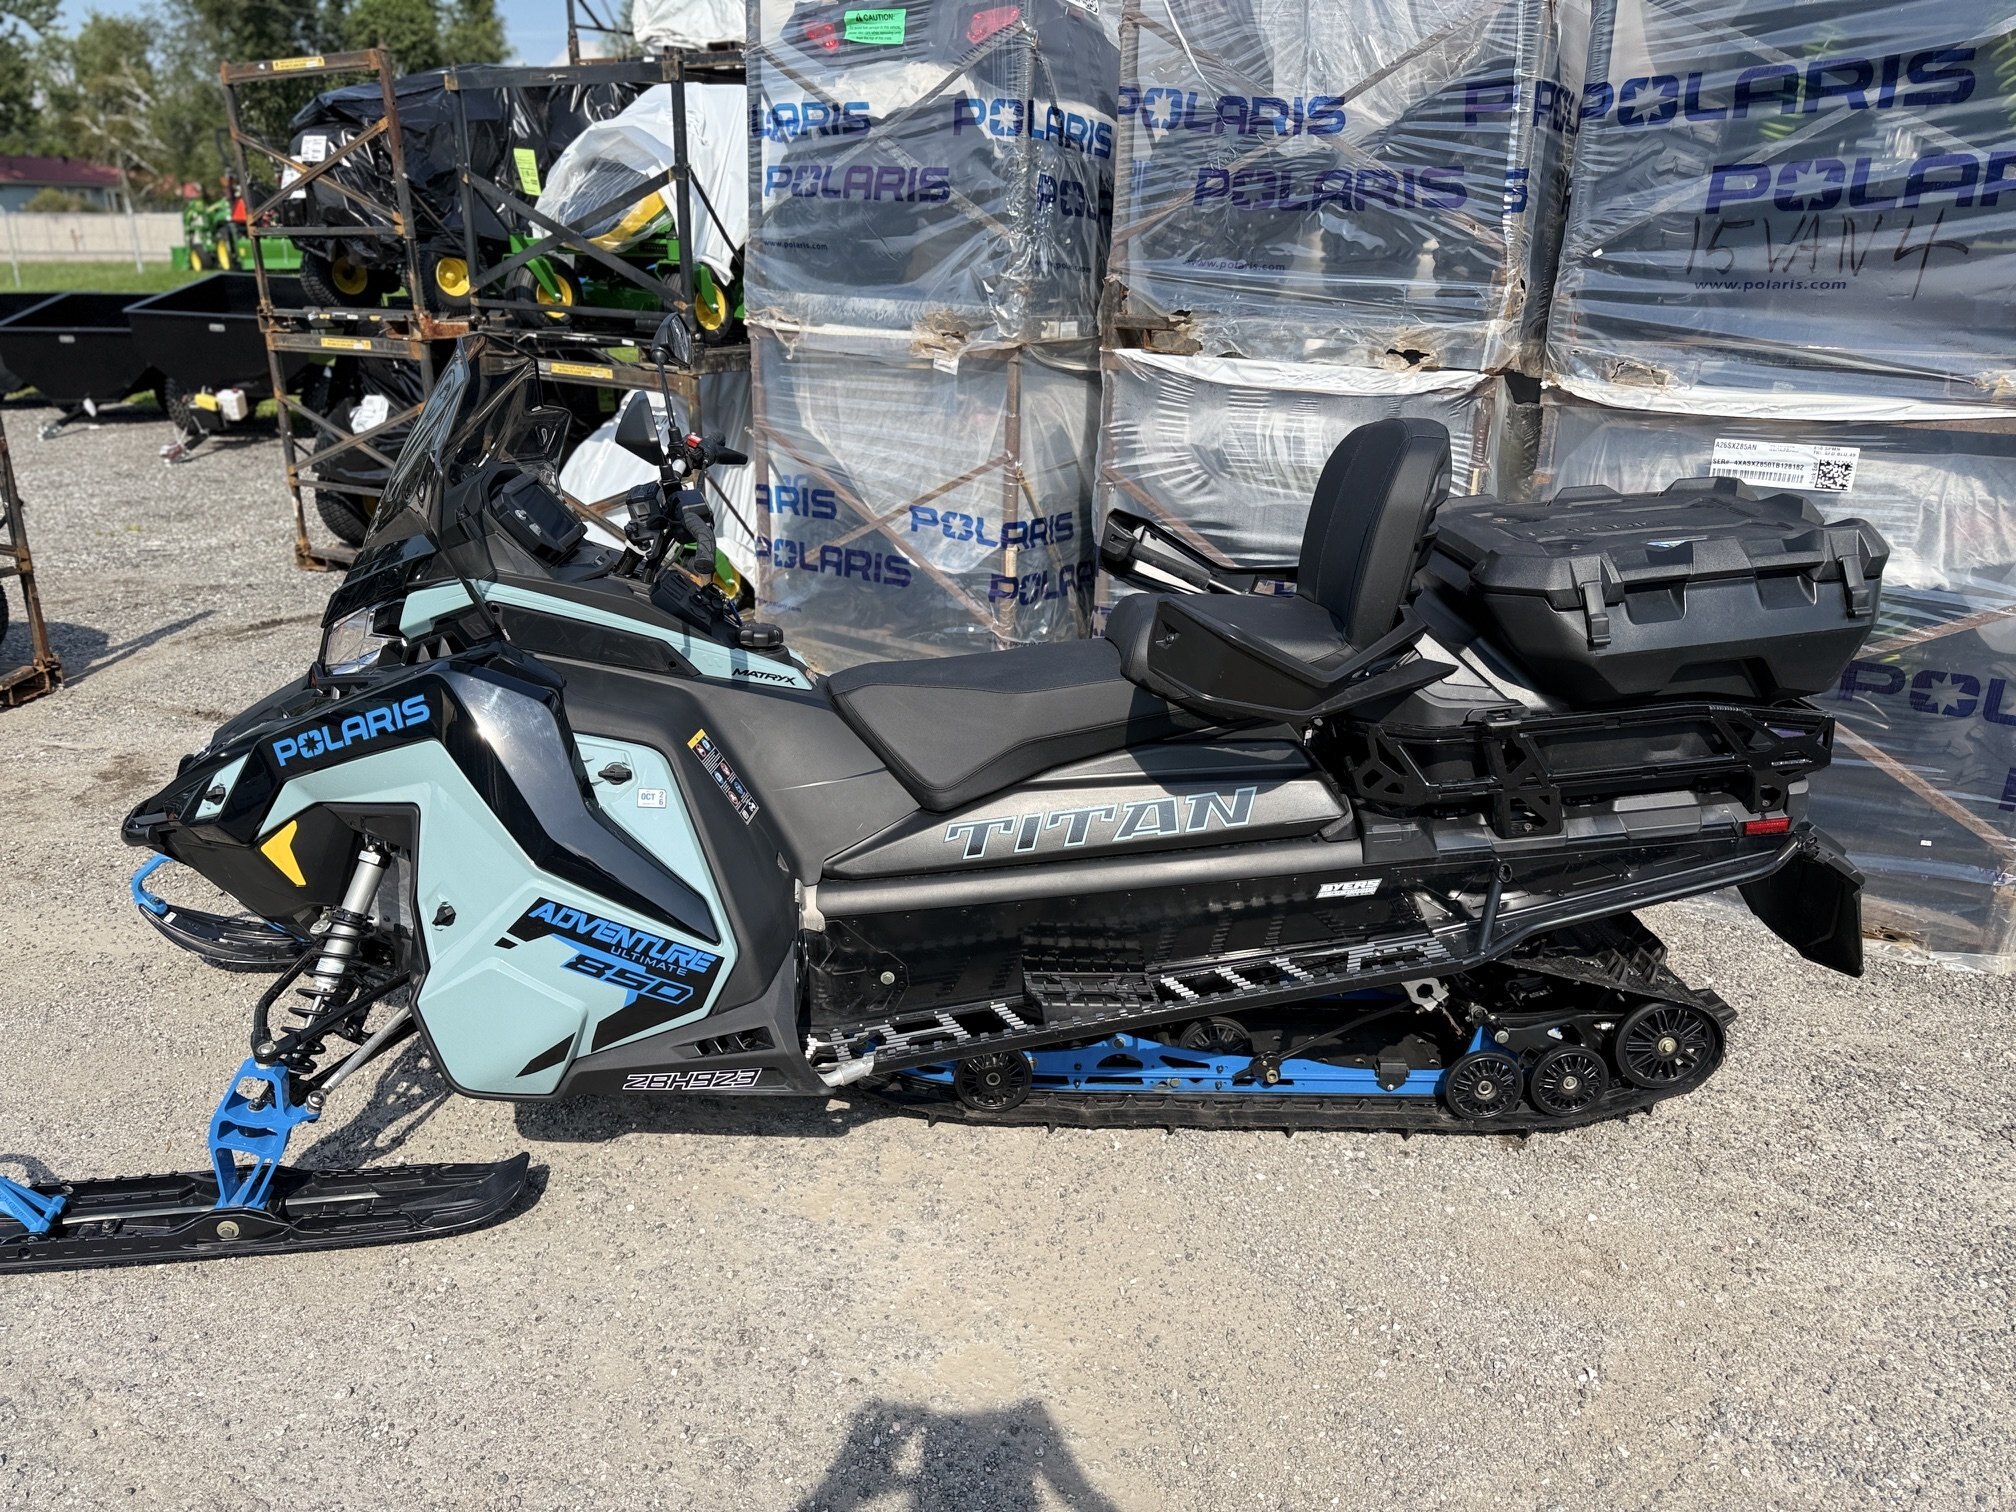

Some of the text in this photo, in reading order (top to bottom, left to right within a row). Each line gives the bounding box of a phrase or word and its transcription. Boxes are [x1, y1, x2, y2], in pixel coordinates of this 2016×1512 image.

[1118, 86, 1346, 136] POLARIS
[1579, 48, 1976, 127] POLARIS
[953, 98, 1112, 160] POLARIS
[764, 165, 950, 203] POLARIS
[1194, 165, 1467, 212] POLARIS
[764, 240, 828, 250] www.polaris.com
[1694, 279, 1848, 291] www.polaris.com
[909, 505, 1074, 550] POLARIS
[731, 668, 796, 686] MATRYX
[272, 694, 431, 767] POLARIS
[641, 793, 656, 801] OCT
[943, 786, 1258, 861] TITAN
[528, 902, 718, 974] ADVENTURE
[610, 946, 688, 977] ULTIMATE
[560, 952, 694, 1005] 850
